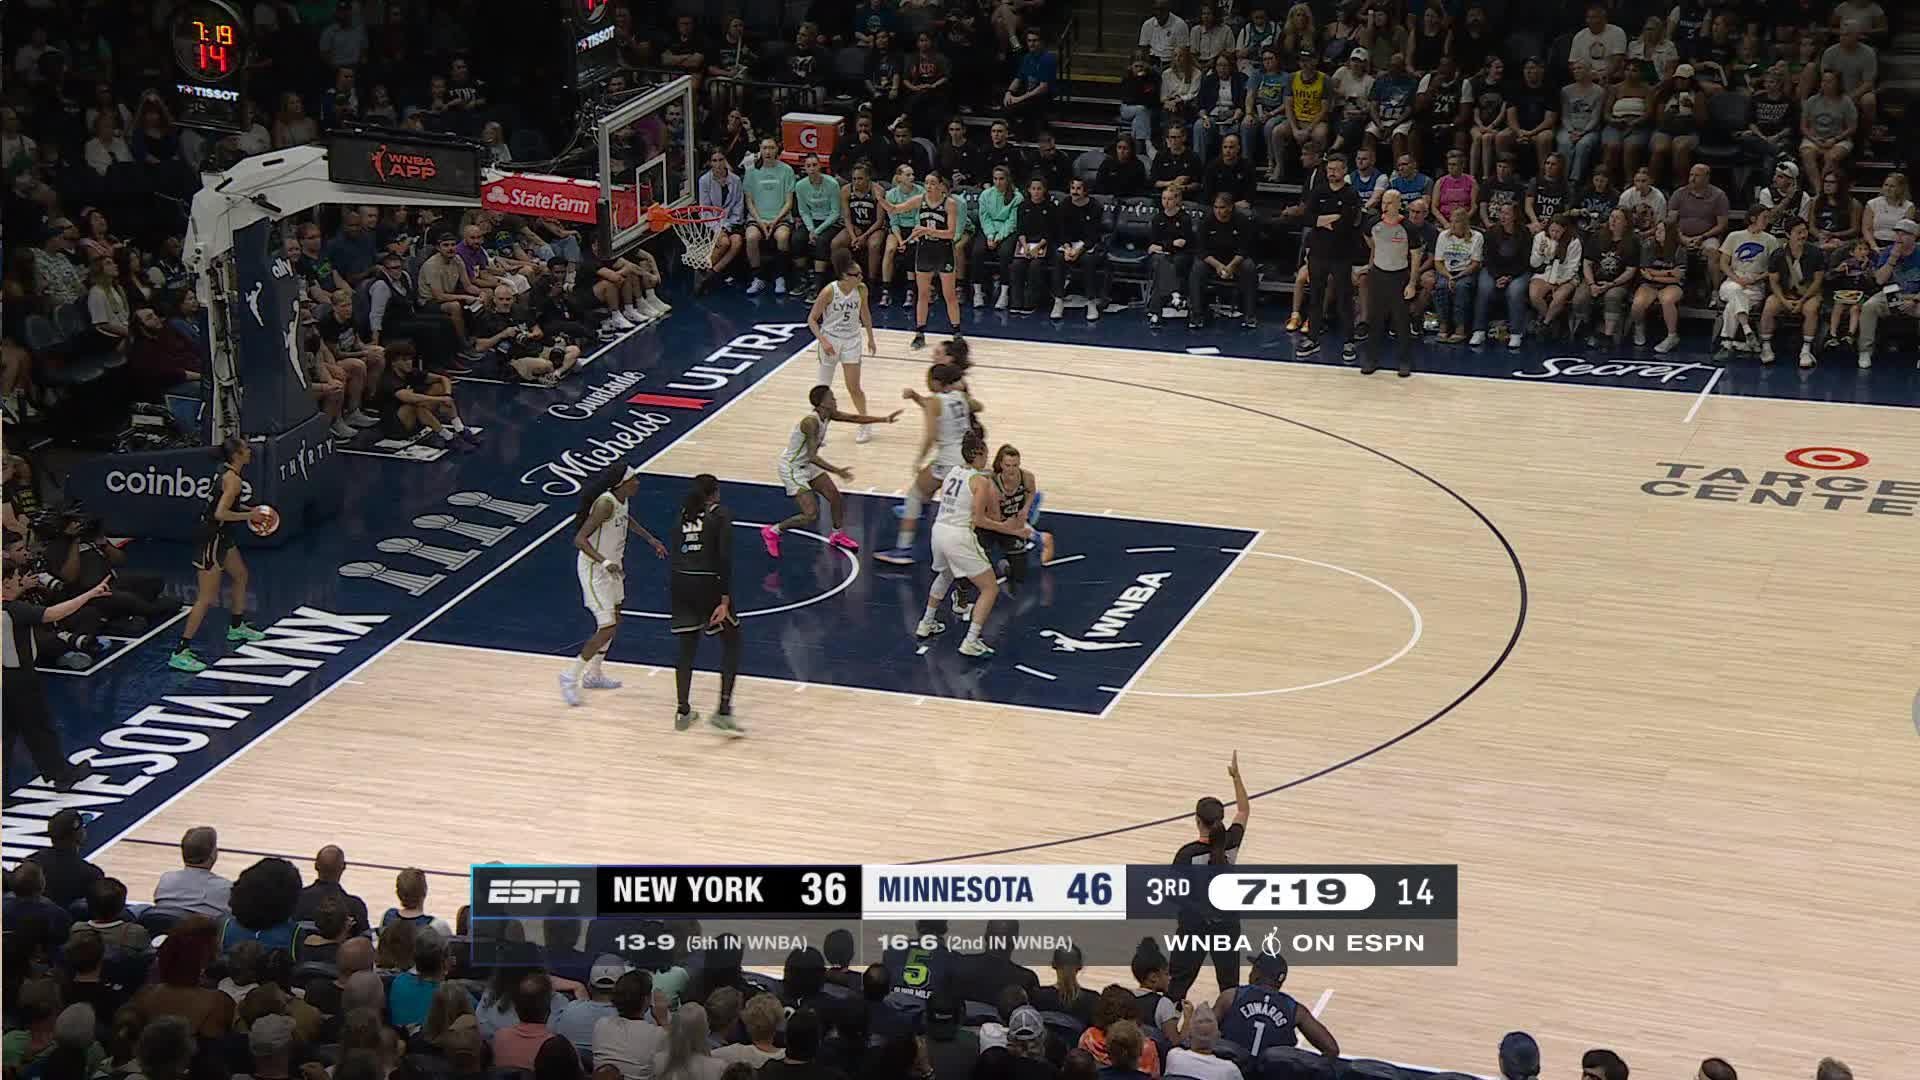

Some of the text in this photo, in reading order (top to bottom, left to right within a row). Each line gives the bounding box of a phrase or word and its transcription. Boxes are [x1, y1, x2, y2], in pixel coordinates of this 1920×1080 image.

[192, 21, 232, 44] 7:19
[586, 25, 616, 49] TISSOT
[200, 43, 227, 72] 14
[194, 86, 239, 101] TISSOT
[800, 128, 818, 150] G
[388, 153, 434, 167] WNBA
[390, 165, 436, 180] APP
[271, 256, 294, 279] ally
[833, 302, 859, 312] LYNX
[843, 311, 851, 322] 5
[520, 322, 808, 496] Michelob ULTRA
[106, 465, 253, 504] coinbae
[946, 477, 963, 498] 21
[1084, 570, 1172, 638] WNBA
[195, 606, 392, 688] LYNX
[904, 948, 931, 986] 5
[1240, 1002, 1288, 1027] EDWARDS
[1251, 1020, 1265, 1057] 1
